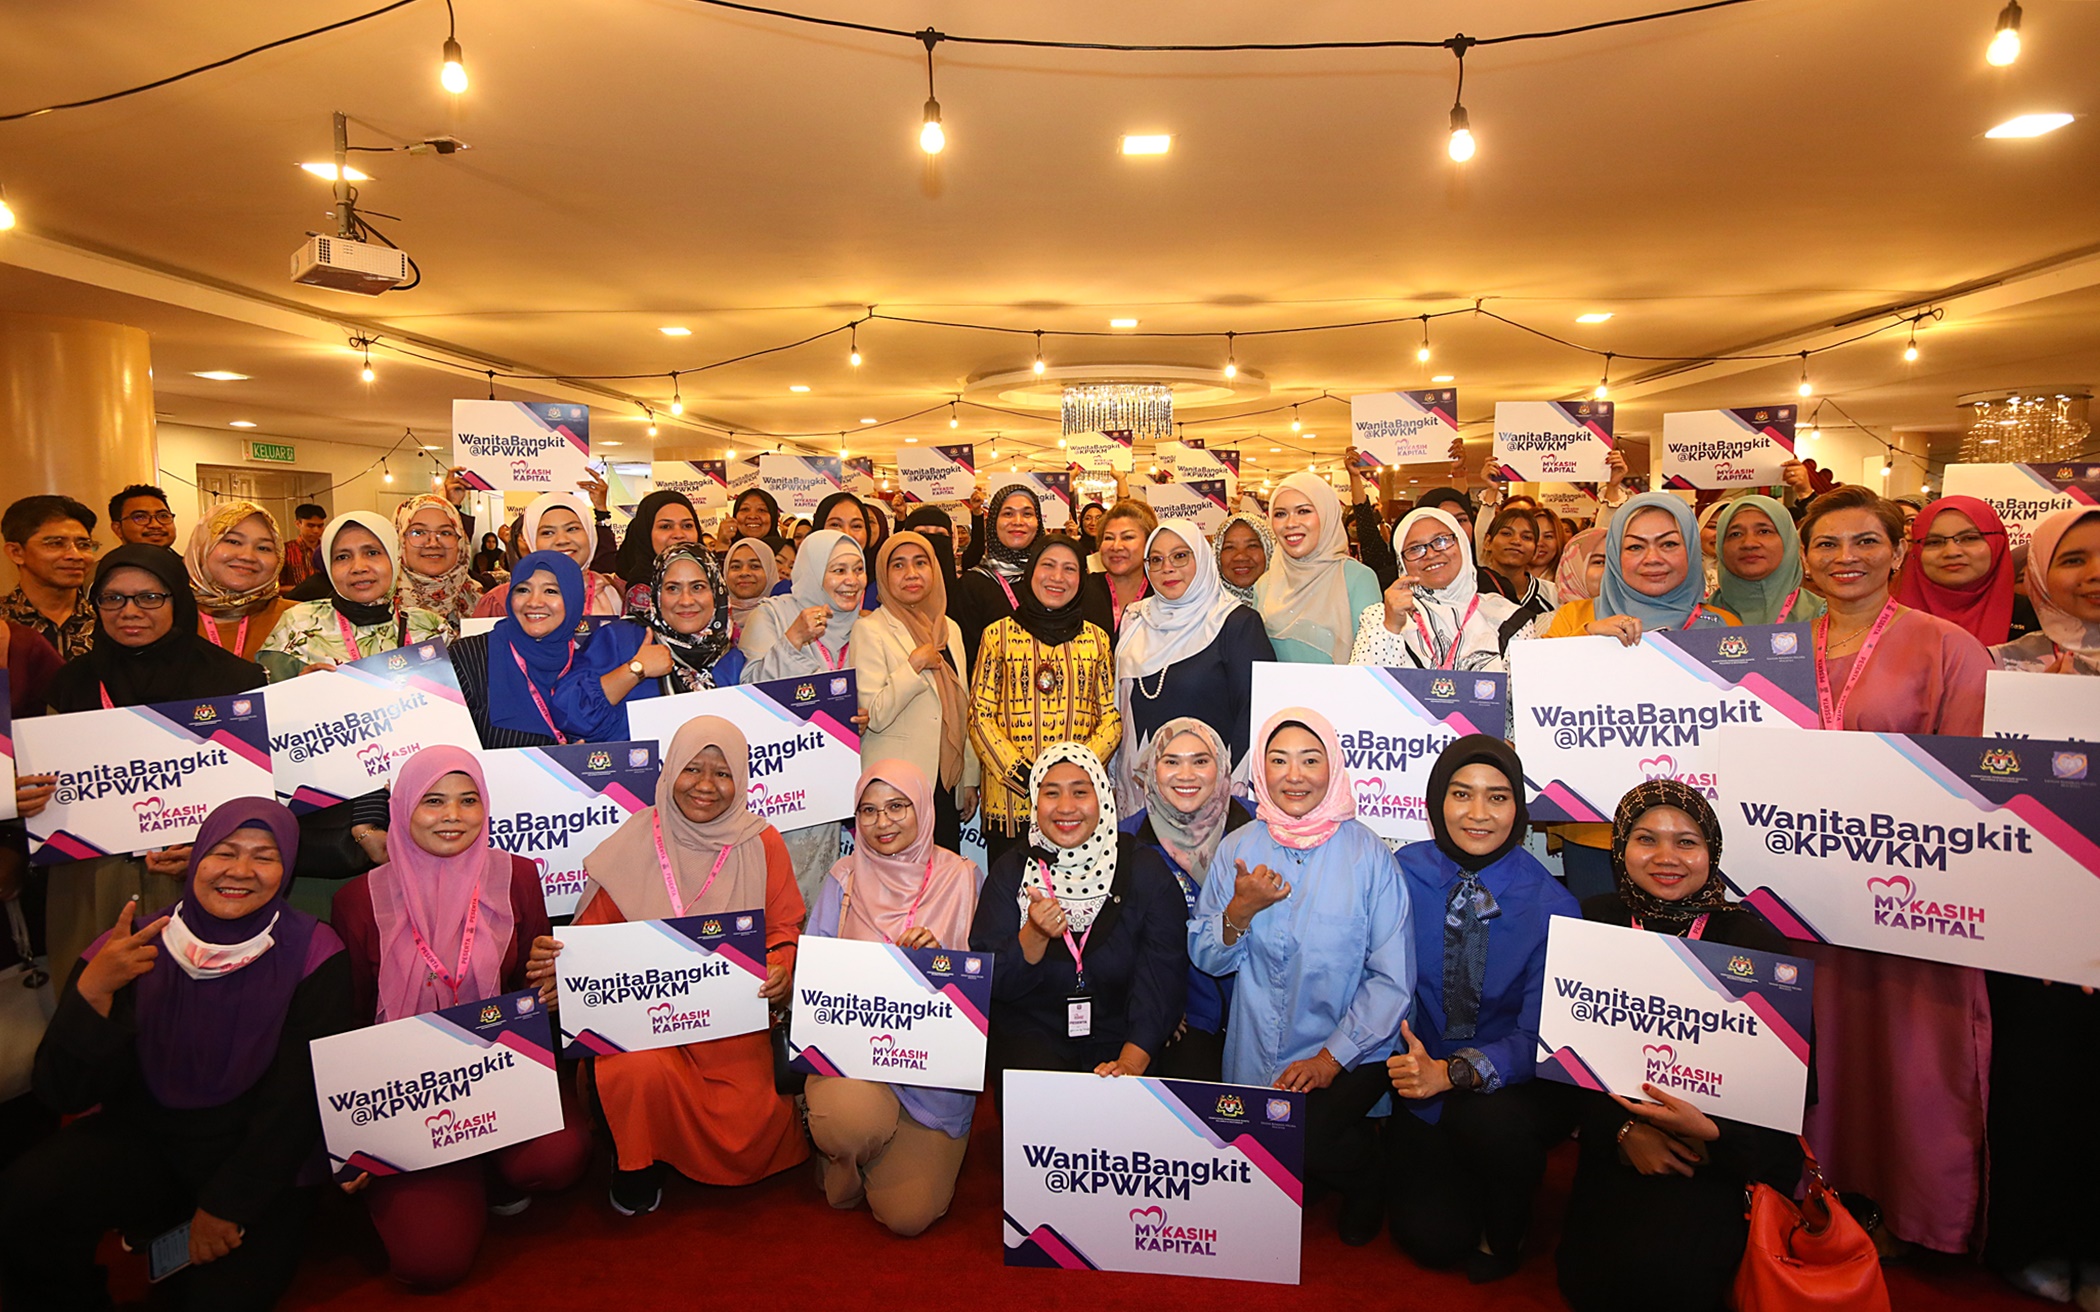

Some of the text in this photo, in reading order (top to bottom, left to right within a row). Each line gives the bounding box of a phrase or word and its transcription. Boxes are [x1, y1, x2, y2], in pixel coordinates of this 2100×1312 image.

[1356, 416, 1438, 431] WanitaBangkit
[1364, 427, 1417, 439] @KPWKM
[458, 433, 565, 450] WanitaBangkit
[1070, 443, 1120, 451] WanitaBangkit
[1499, 431, 1592, 444] WanitaBangkit
[1507, 442, 1567, 451] @KPWKM
[1668, 437, 1770, 453] WanitaBangkit
[254, 444, 286, 459] KELUAR
[469, 445, 538, 457] @KPWKM
[1677, 450, 1743, 463] @KPWKM
[901, 465, 961, 477] WanitaBangkit
[907, 474, 947, 482] @KPWKM
[1177, 465, 1228, 475] WanitaBangkit
[655, 479, 714, 489] WanitaBangkit
[762, 477, 827, 487] WanitaBangkit
[1984, 498, 2073, 513] itaBangkit
[1997, 509, 2037, 520] WKM
[1871, 613, 1890, 636] PESERTA
[1816, 658, 1826, 684] PESERTA
[1851, 656, 1867, 681] PESERTA
[536, 697, 548, 717] PESERTA
[1531, 699, 1763, 730] WanitaBangkit
[1822, 698, 1832, 724] PESERTA
[269, 692, 428, 752] WanitaBangkit
[289, 716, 394, 763] @KPWKM
[1554, 725, 1700, 750] @KPWKM
[1344, 750, 1407, 772] WKM
[54, 773, 182, 805] @KPWKM
[1646, 773, 1718, 786] MYKASI
[1359, 793, 1428, 808] MYKASIH
[139, 803, 207, 823] MYKASIH
[140, 815, 204, 833] KAPITAL
[489, 805, 619, 835] taBangkit
[1358, 805, 1427, 822] KAPITAL
[1740, 801, 2033, 854] WanitaBangkit
[656, 836, 666, 860] PESERTA
[1765, 830, 1947, 872] @KPWKM
[666, 872, 677, 897] PESERTA
[470, 898, 478, 923] PESERTA
[1875, 895, 1985, 923] MYKASIH
[1875, 910, 1985, 941] KAPITAL
[421, 946, 440, 970] PESERTA
[461, 938, 472, 965] PESERTA
[565, 961, 730, 993] WanitaBangkit
[583, 981, 690, 1007] @KPWKM
[801, 988, 953, 1019] WanitaBangkit
[652, 1009, 710, 1025] MYKASIH
[1554, 976, 1758, 1036] WanitaBangkit
[652, 1019, 711, 1034] KAPITAL
[814, 1008, 912, 1031] @KPWKM
[1571, 1001, 1701, 1045] @KPWKM
[872, 1056, 927, 1070] KAPITAL
[873, 1047, 928, 1060] MYKASIH
[328, 1051, 515, 1113] WanitaBangkit
[1646, 1057, 1723, 1085] MYKASIH
[1645, 1070, 1721, 1098] KAPITAL
[351, 1079, 471, 1126] @KPWKM
[431, 1111, 497, 1139] MYKASIH
[433, 1123, 498, 1149] KAPITAL
[1023, 1144, 1251, 1185] WanitaBangkit
[1045, 1170, 1191, 1201] @KPWKM
[1135, 1223, 1217, 1242] MYKASIH
[1135, 1237, 1217, 1256] KAPITAL
